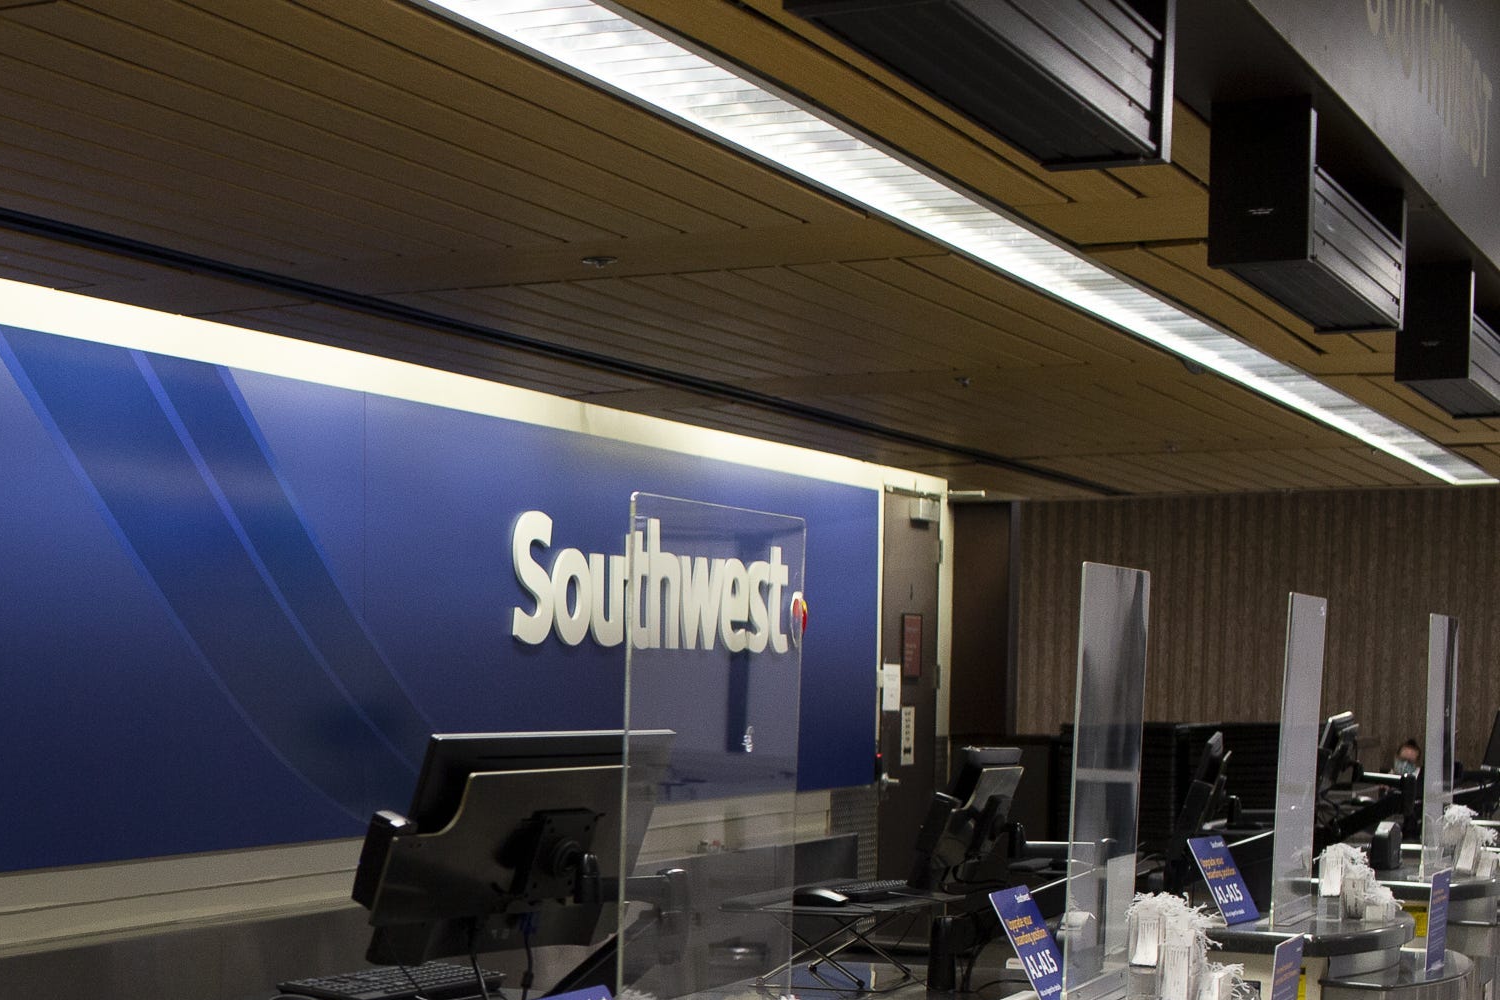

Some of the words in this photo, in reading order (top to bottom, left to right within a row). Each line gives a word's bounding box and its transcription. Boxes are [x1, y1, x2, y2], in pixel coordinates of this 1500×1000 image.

[512, 510, 788, 653] Southwest
[1214, 883, 1243, 904] A1-A15
[1025, 949, 1058, 980] A1-A15
